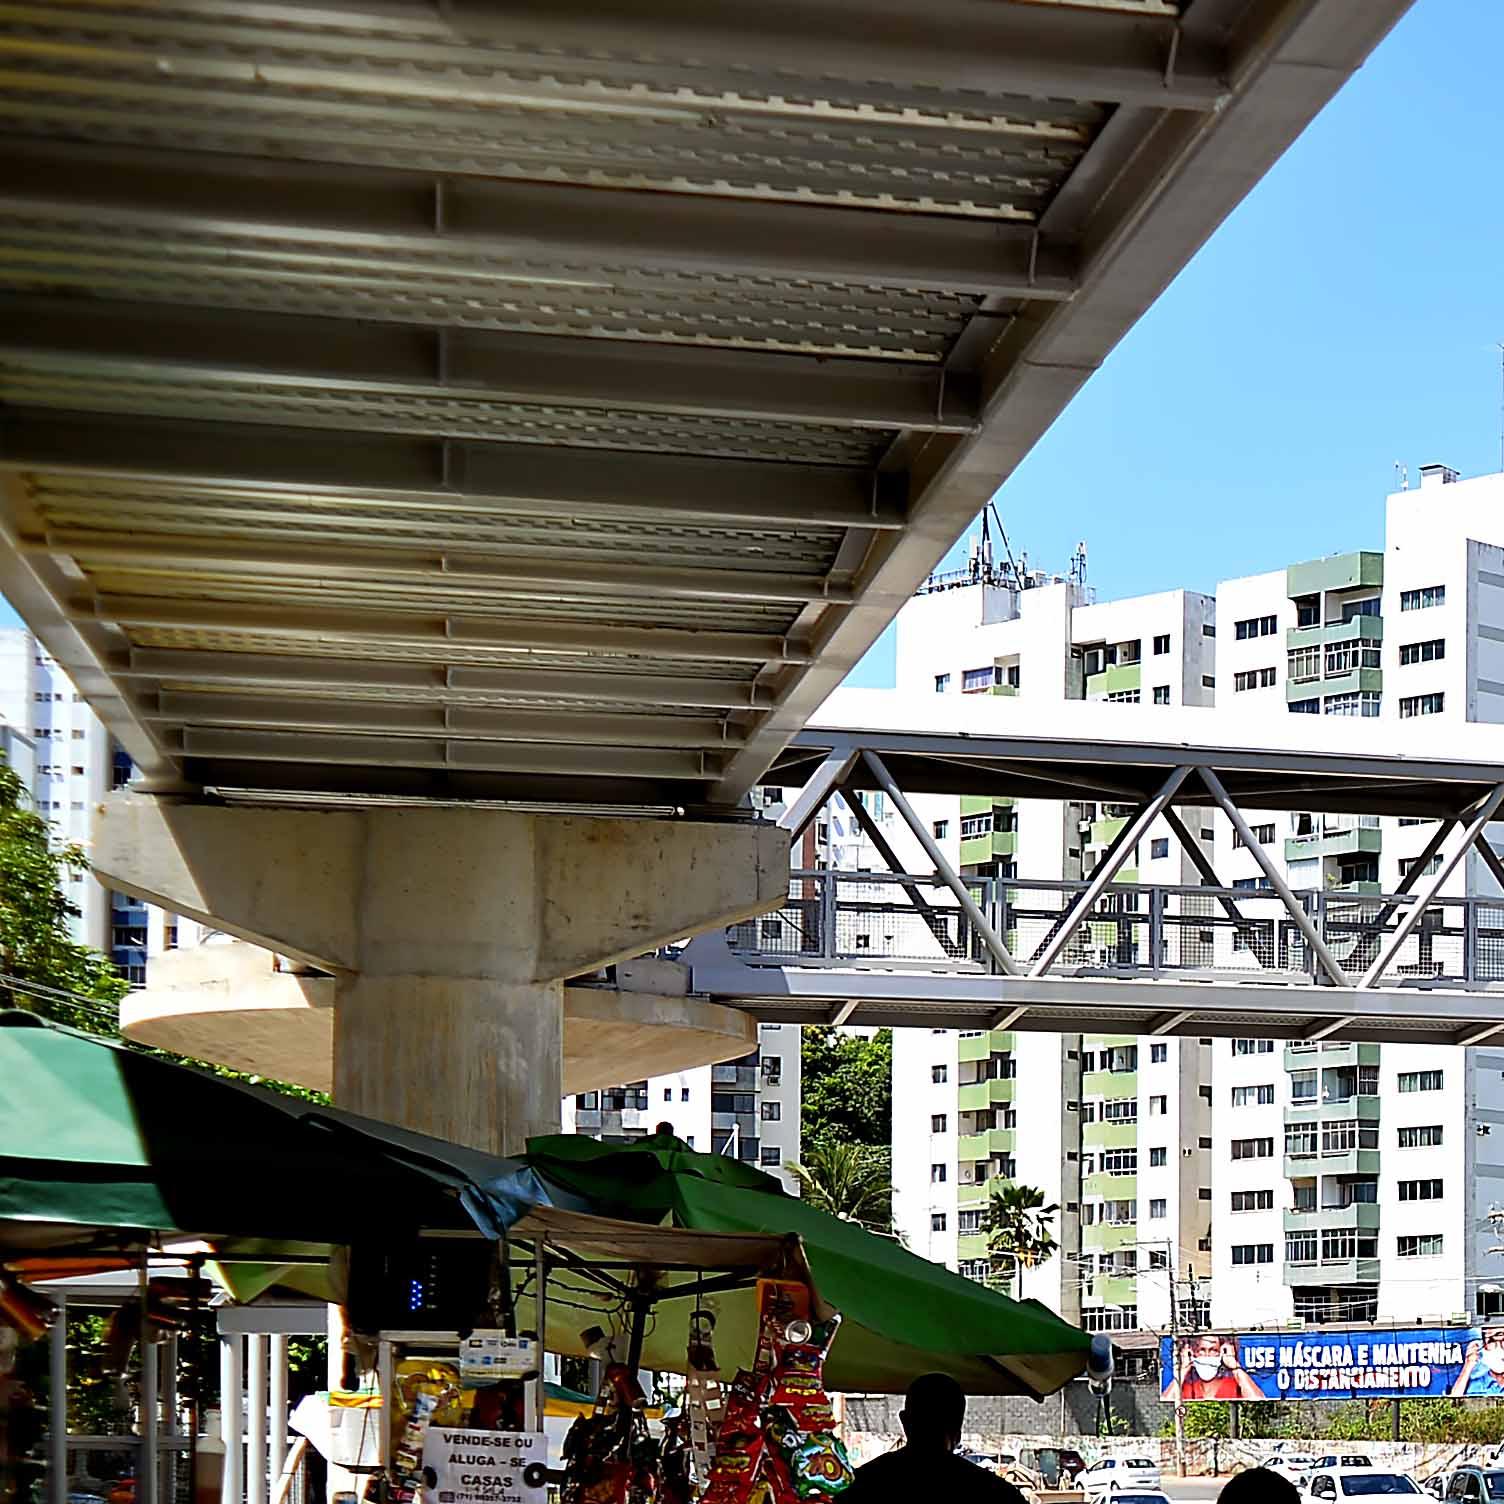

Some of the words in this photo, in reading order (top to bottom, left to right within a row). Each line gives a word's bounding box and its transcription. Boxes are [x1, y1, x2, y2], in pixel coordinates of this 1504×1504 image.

[1244, 1345, 1276, 1368] USE
[1279, 1341, 1354, 1368] MÁSCARA
[1357, 1345, 1369, 1366] E
[1372, 1342, 1464, 1365] MANTENHA
[1277, 1367, 1290, 1390] O
[1293, 1365, 1431, 1391] DISTANCIAMENTO
[443, 1433, 511, 1448] VENDE-SE
[514, 1437, 533, 1448] OU
[447, 1453, 496, 1467] ALUGA
[509, 1456, 527, 1468] SE
[461, 1474, 513, 1488] CASAS
